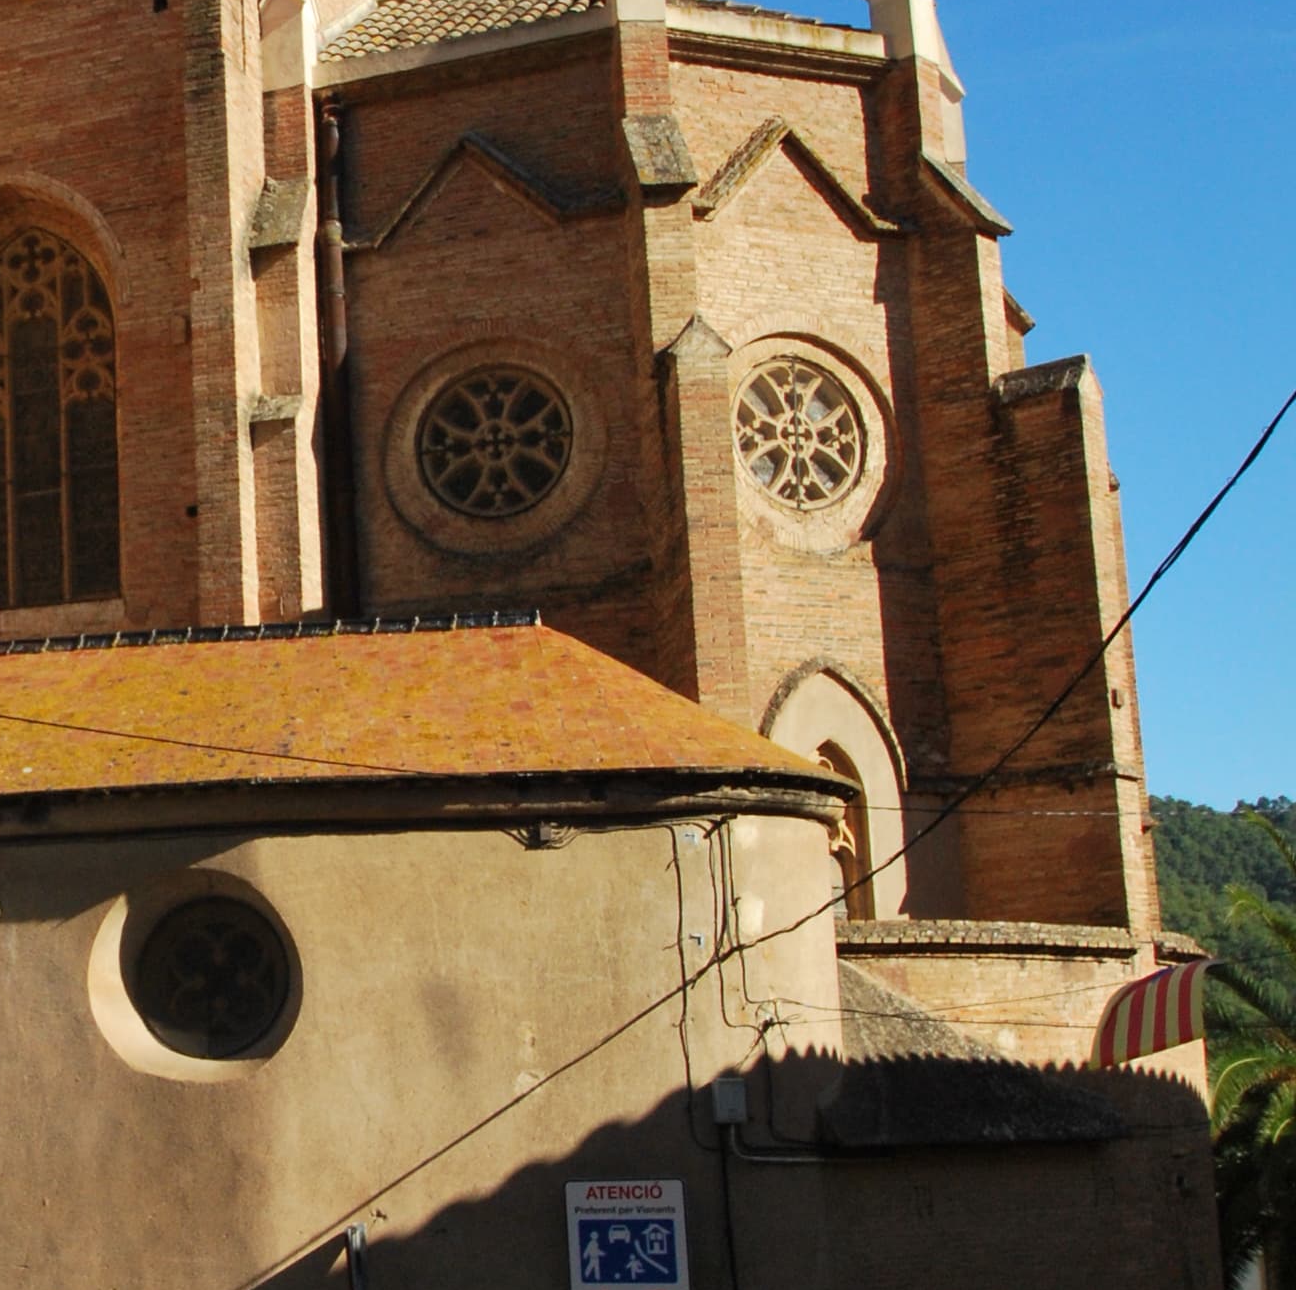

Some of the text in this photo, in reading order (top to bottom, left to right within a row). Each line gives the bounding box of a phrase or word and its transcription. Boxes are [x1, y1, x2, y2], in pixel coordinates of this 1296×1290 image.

[585, 1181, 664, 1200] ATENCIÓ
[574, 1206, 618, 1215] Preferent
[636, 1206, 676, 1215] Vianants
